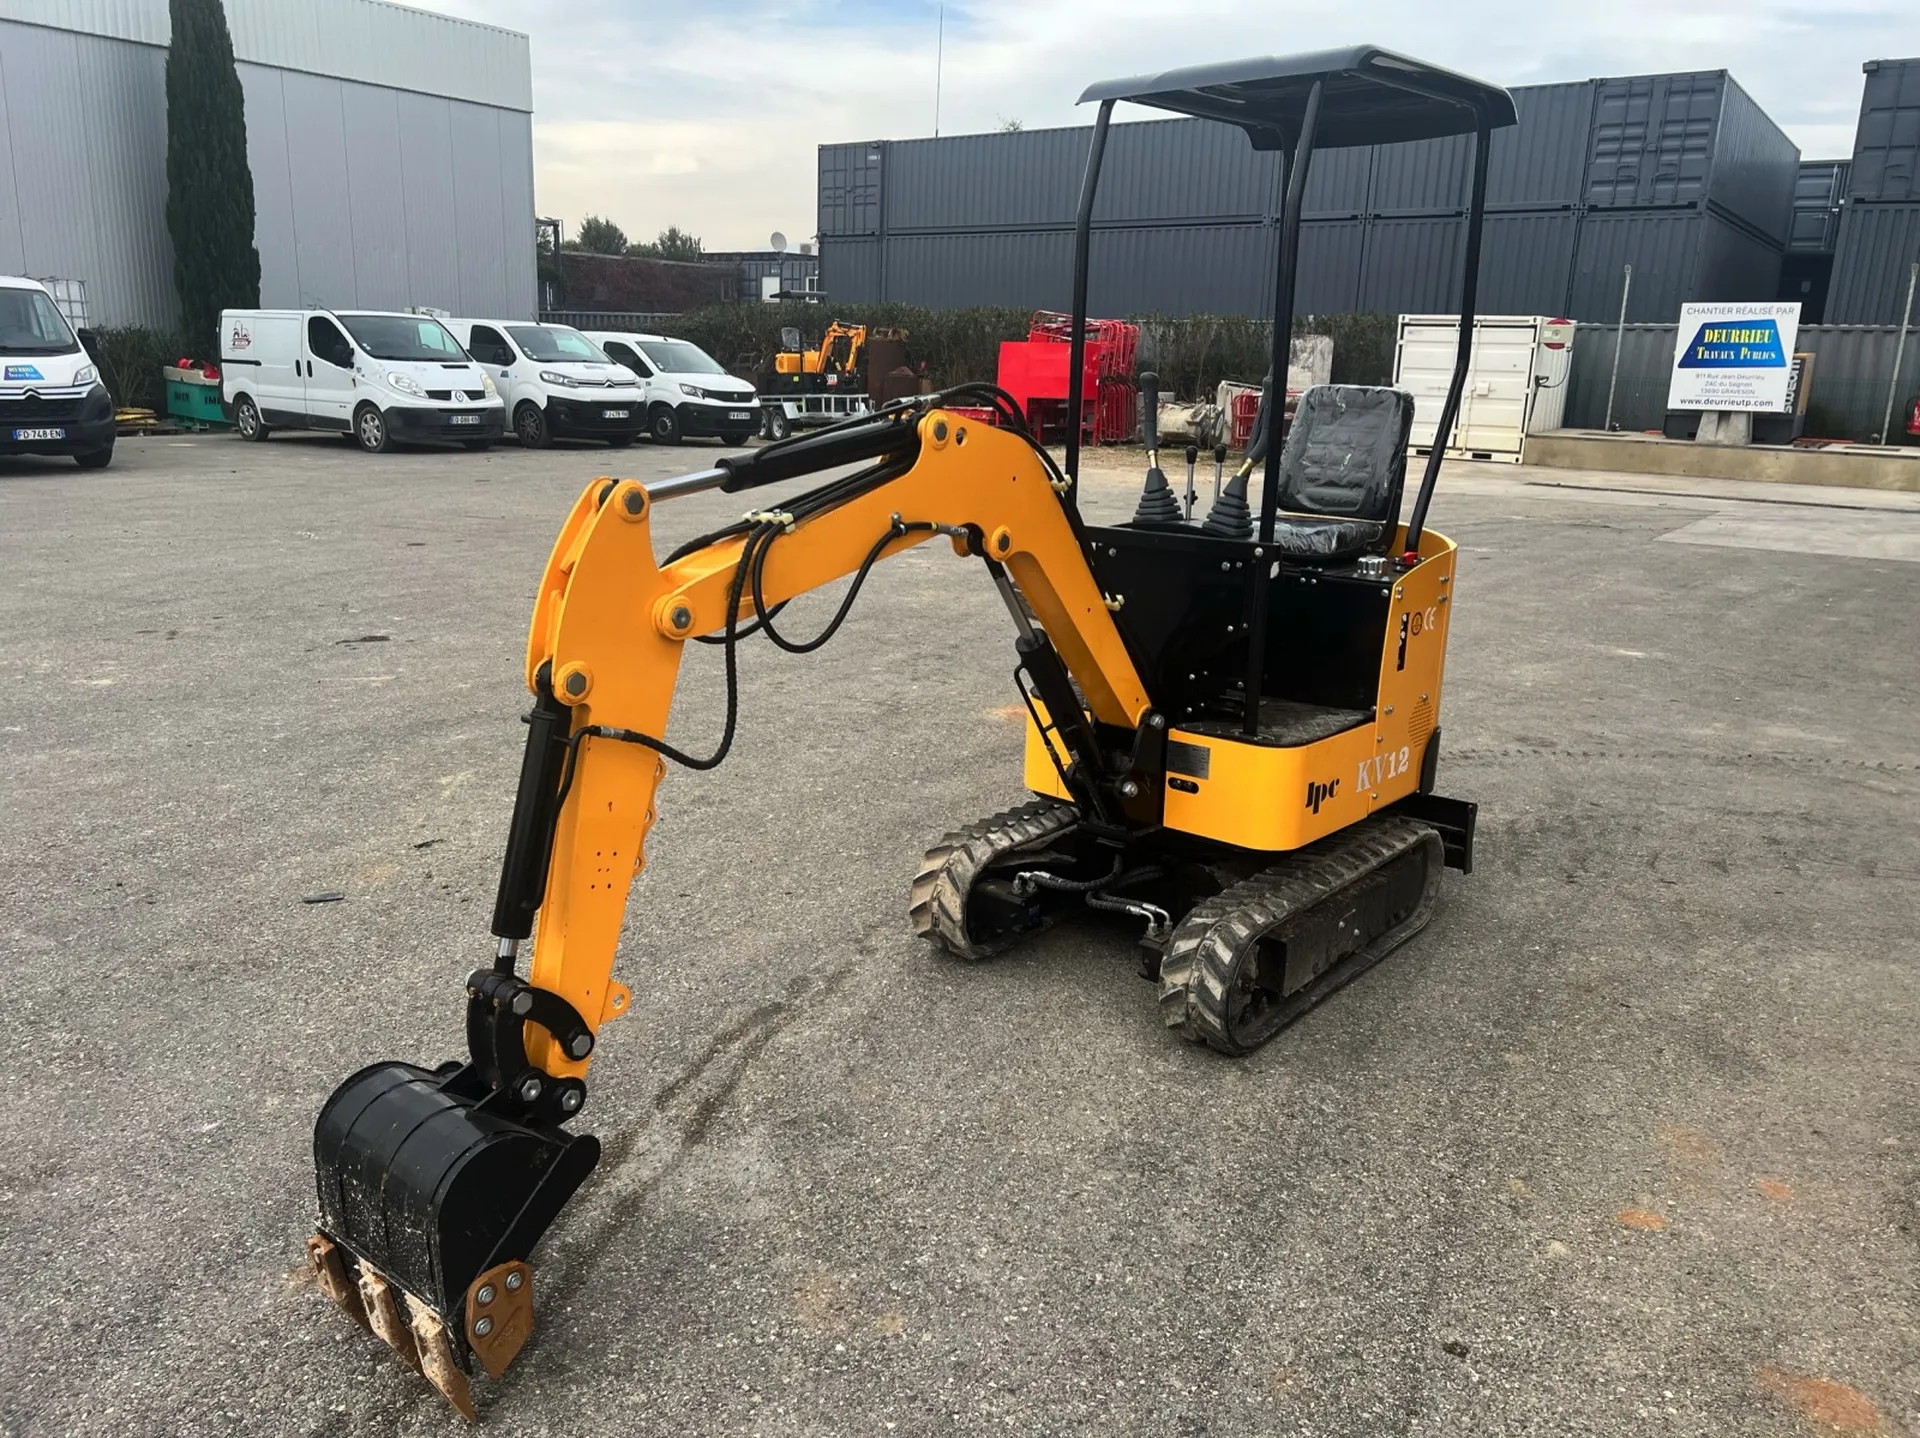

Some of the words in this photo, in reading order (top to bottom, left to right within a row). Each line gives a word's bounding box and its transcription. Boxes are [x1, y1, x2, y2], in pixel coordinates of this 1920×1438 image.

[1686, 307, 1734, 315] CHANTIER
[1735, 304, 1774, 315] RÉALISÉ
[1776, 306, 1795, 315] PAR
[1703, 328, 1774, 344] DEURRIEU
[1680, 397, 1774, 407] www.deurrieutp.com
[1355, 745, 1410, 793] KV12
